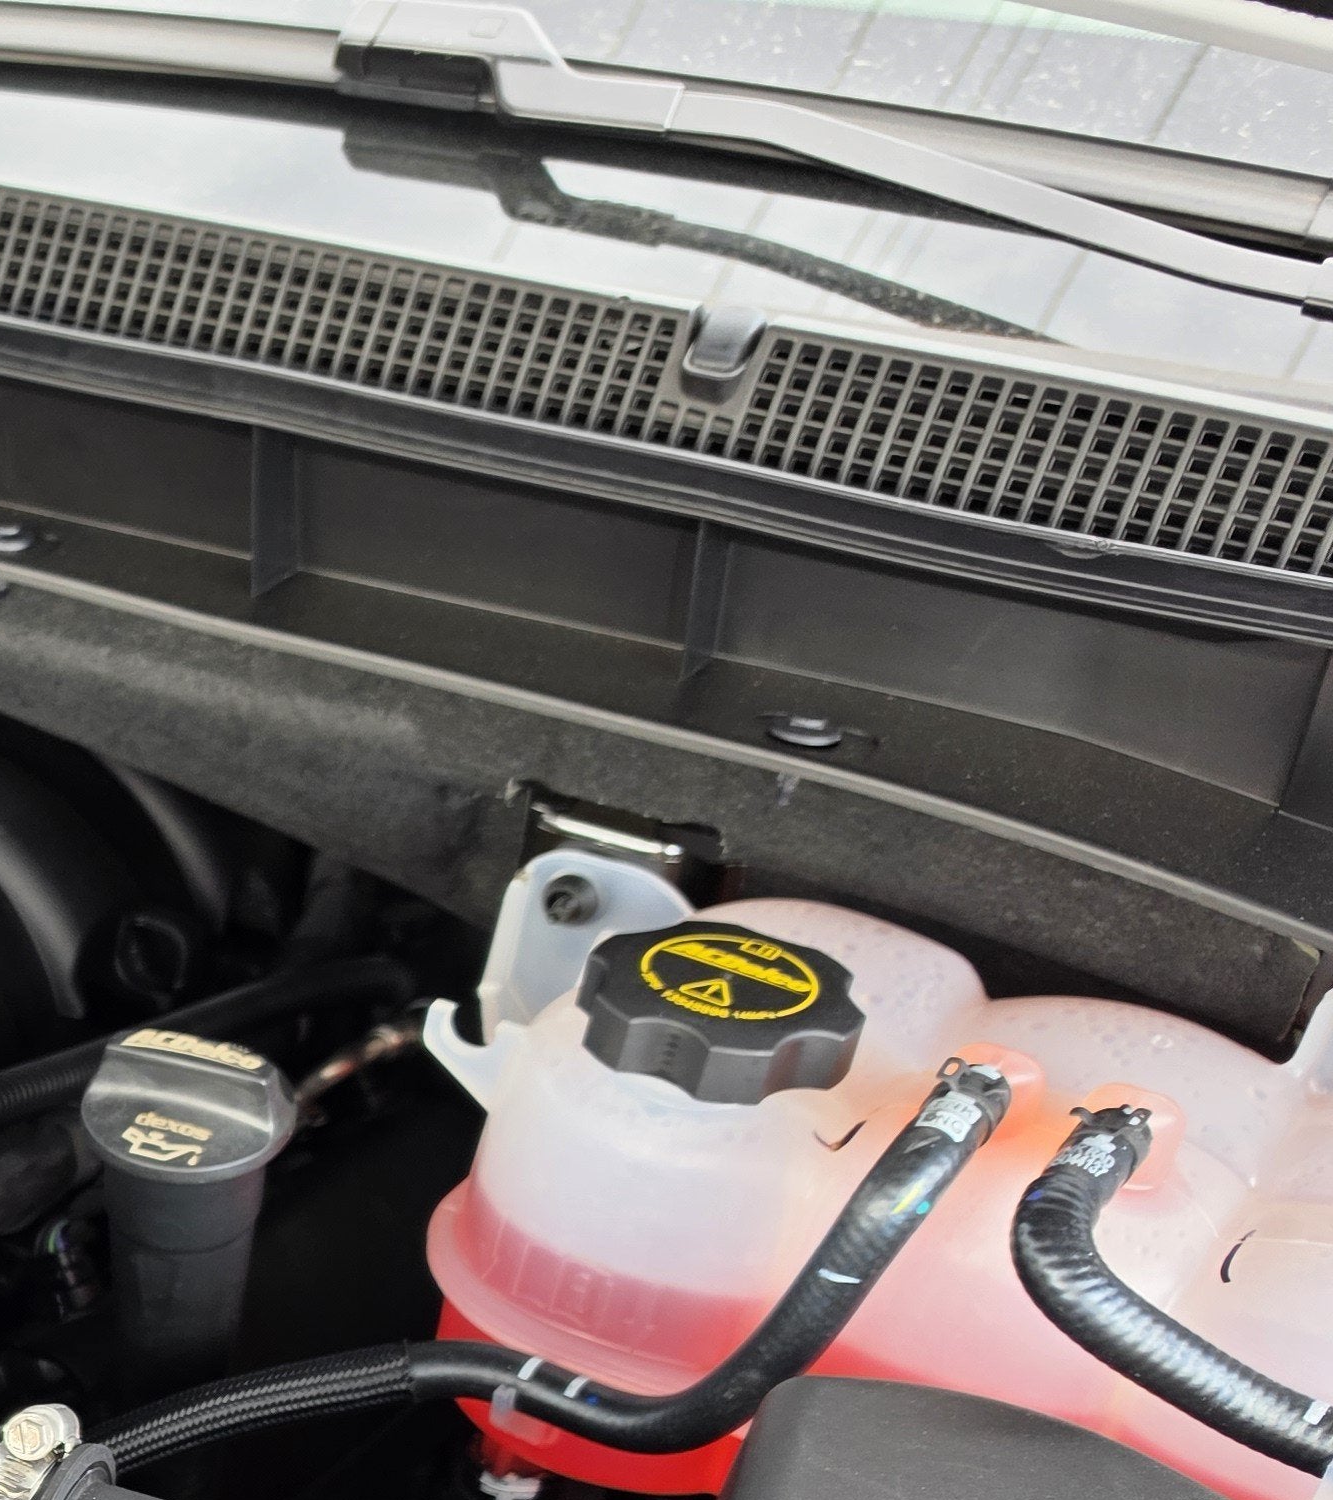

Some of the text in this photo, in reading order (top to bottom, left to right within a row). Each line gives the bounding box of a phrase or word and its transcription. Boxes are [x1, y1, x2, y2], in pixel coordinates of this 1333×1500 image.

[664, 942, 812, 993] ACDelco
[120, 1028, 265, 1071] ACDelco
[134, 1110, 213, 1141] dexos
